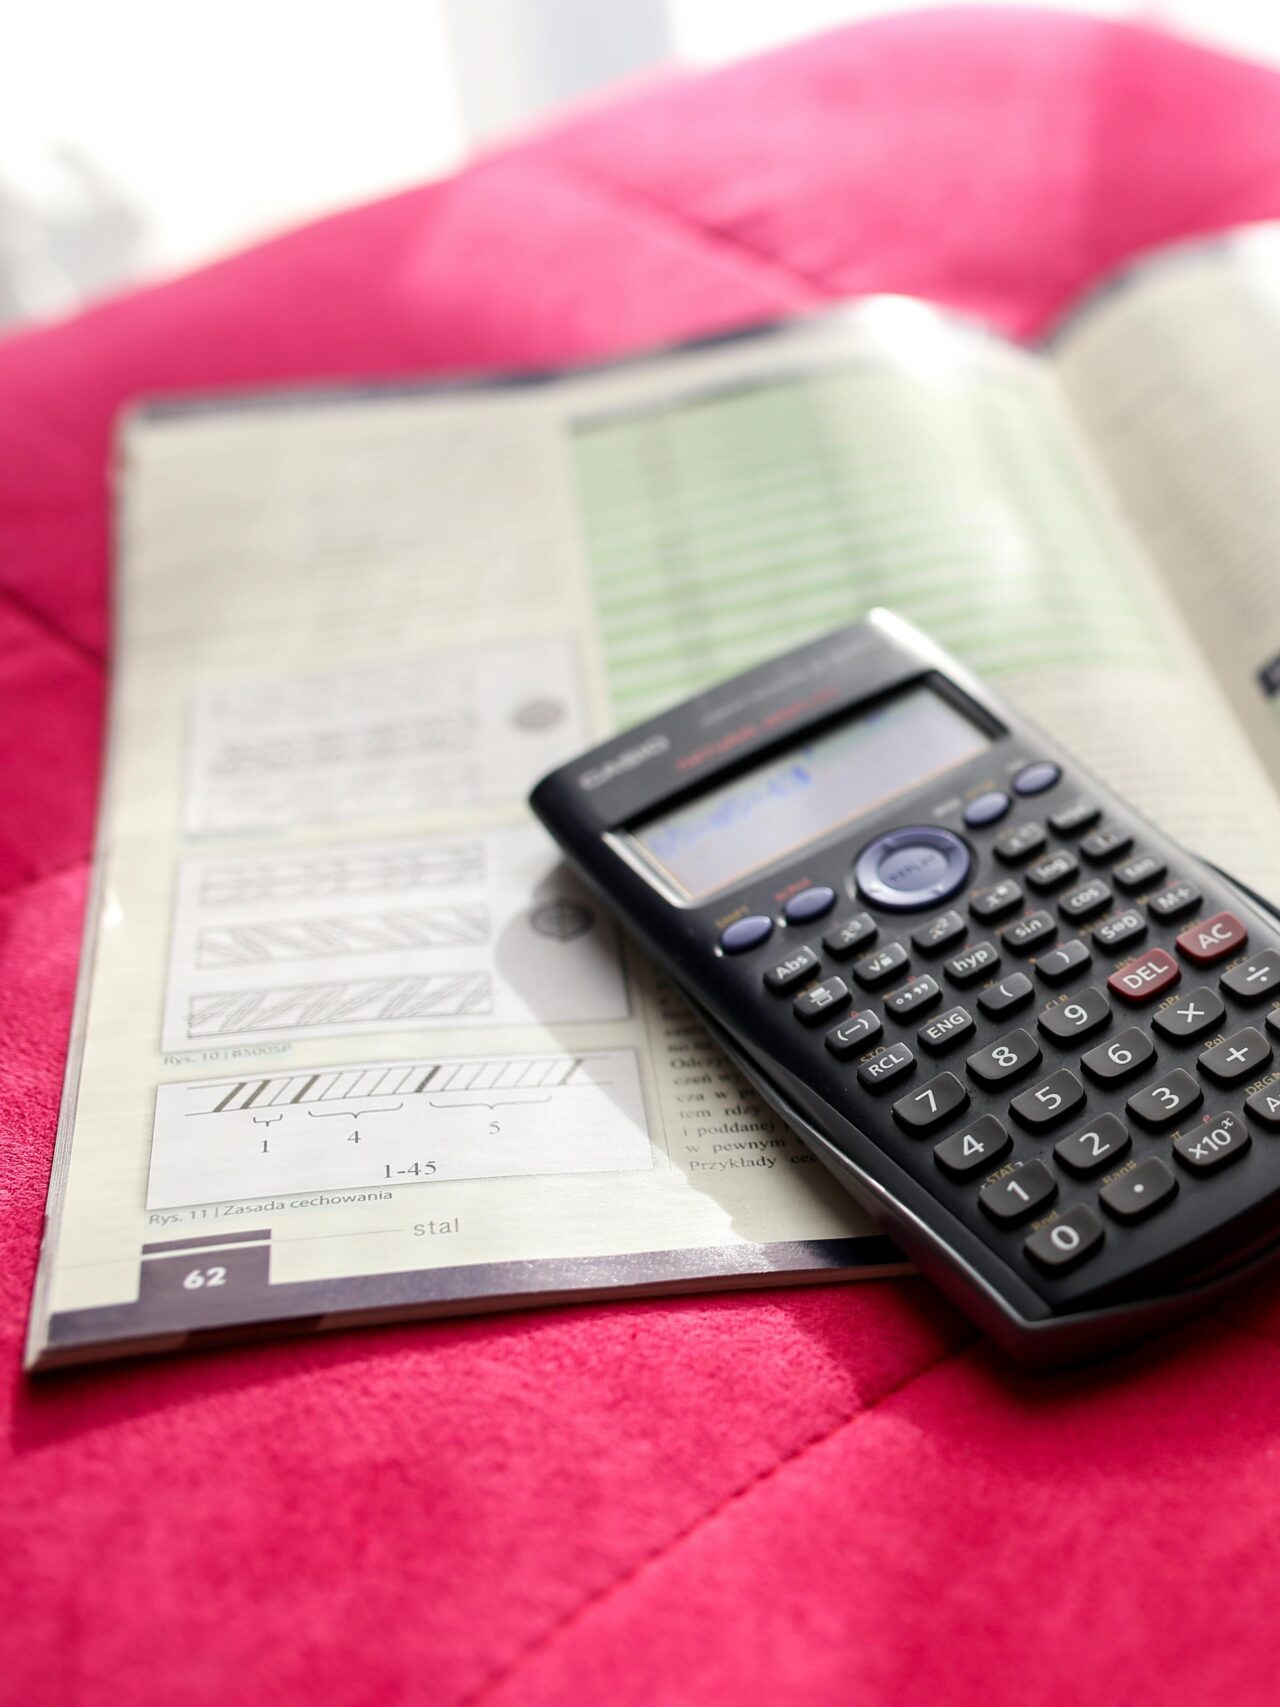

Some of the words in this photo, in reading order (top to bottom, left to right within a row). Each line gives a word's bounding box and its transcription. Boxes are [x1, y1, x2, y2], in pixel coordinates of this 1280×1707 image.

[1071, 888, 1100, 907] cos
[1015, 918, 1042, 938] sin
[1198, 923, 1233, 950] AC
[775, 955, 808, 980] Abs
[953, 951, 988, 971] hyp
[1122, 961, 1169, 989] DEL
[1064, 1004, 1088, 1025] 9
[926, 1013, 965, 1039] ENG
[202, 1052, 220, 1061] 10
[991, 1046, 1018, 1067] 8
[1107, 1043, 1132, 1065] 6
[868, 1053, 905, 1077] RCL
[915, 1089, 938, 1113] 7
[1034, 1085, 1062, 1110] 5
[1152, 1087, 1180, 1109] 3
[347, 1130, 362, 1143] 4
[488, 1120, 500, 1134] 5
[697, 1121, 775, 1138] poddanej
[261, 1140, 269, 1153] 1
[712, 1138, 786, 1154] pewnym
[963, 1134, 985, 1156] 4
[1079, 1132, 1111, 1156] 2
[383, 1160, 437, 1179] 1-45
[689, 1156, 777, 1172] Przykłady
[986, 1164, 1015, 1185] STAT
[1102, 1160, 1138, 1186] Ran#
[1007, 1180, 1029, 1201] 1
[149, 1213, 183, 1226] Rys.
[190, 1210, 207, 1220] 11
[223, 1201, 285, 1216] Zasada
[290, 1190, 393, 1210] cechowania
[413, 1217, 459, 1237] stal
[1051, 1225, 1080, 1250] 0
[183, 1266, 227, 1290] 62
